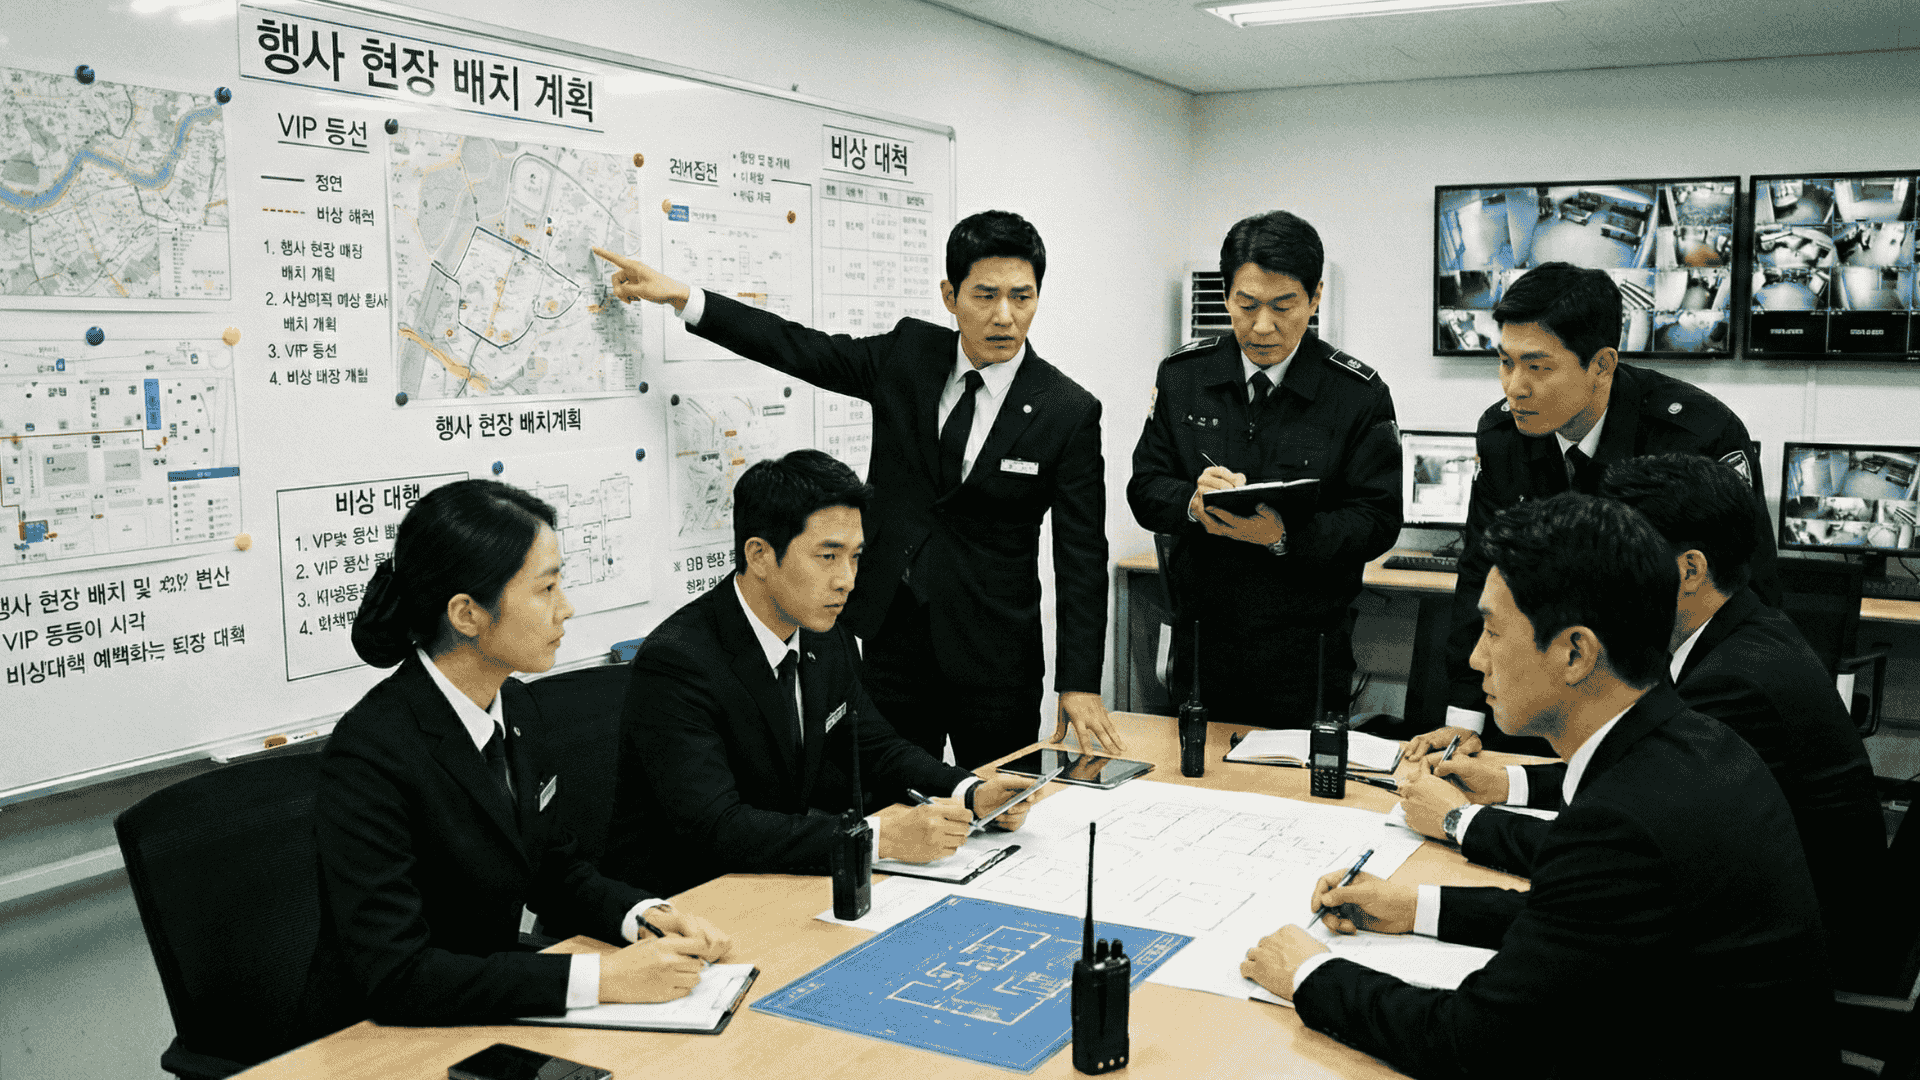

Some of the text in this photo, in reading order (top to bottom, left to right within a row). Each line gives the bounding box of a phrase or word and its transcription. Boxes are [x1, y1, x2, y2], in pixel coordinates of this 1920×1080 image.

[257, 18, 594, 123] 행사 현장 배치 계획
[278, 113, 317, 139] VIP
[832, 135, 868, 170] 비상
[263, 239, 275, 255] 1.
[281, 239, 306, 257] 행사
[311, 241, 335, 258] 현장
[281, 265, 306, 281] 배치
[266, 291, 277, 306] 2.
[283, 316, 308, 332] 배치
[268, 343, 280, 359] 3.
[269, 371, 281, 386] 4.
[287, 369, 312, 386] 비상
[435, 414, 472, 441] 행사
[478, 412, 513, 437] 현장
[336, 487, 375, 516] 비상
[295, 535, 308, 551] 1.
[296, 564, 309, 580] 2.
[314, 560, 338, 576] VIP
[39, 587, 80, 614] 현장
[87, 580, 125, 605] 배치
[134, 577, 151, 600] 및
[297, 592, 311, 608] 3.
[299, 620, 313, 636] 4.
[2, 630, 39, 651] VIP
